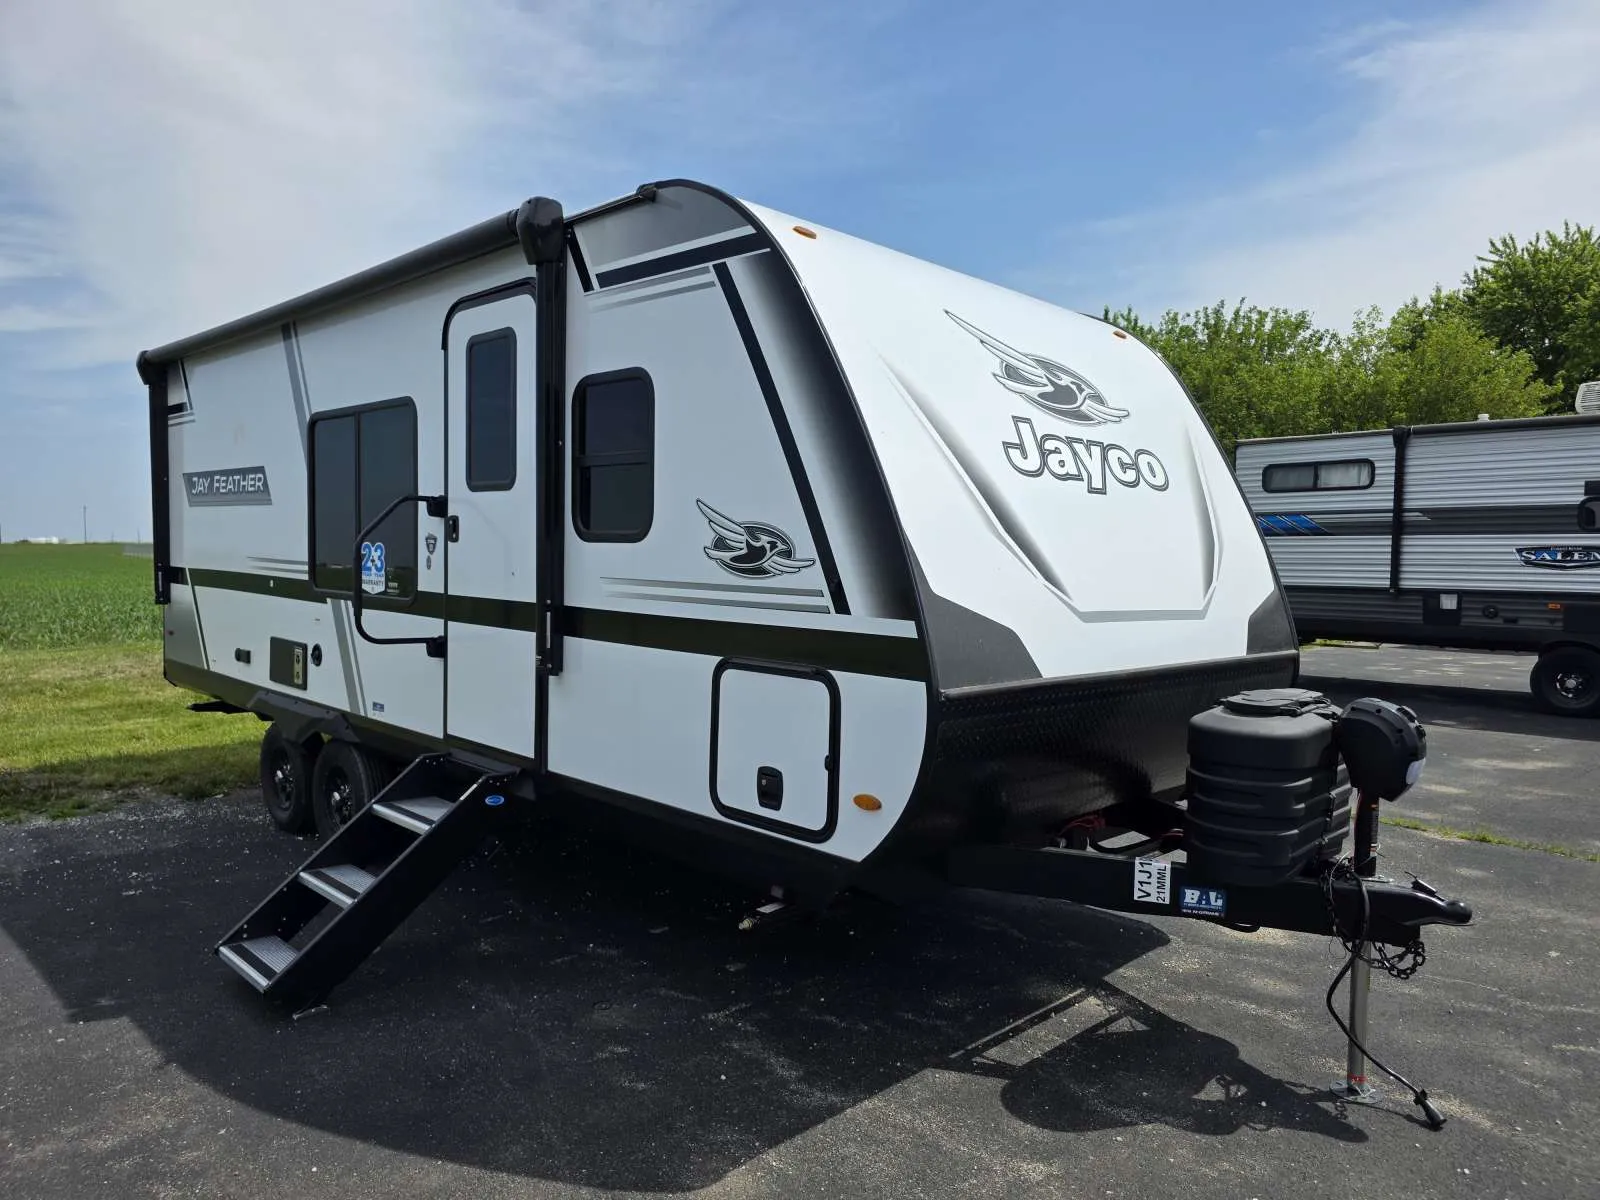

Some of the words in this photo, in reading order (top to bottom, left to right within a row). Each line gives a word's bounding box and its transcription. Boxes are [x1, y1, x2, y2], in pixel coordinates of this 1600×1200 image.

[1002, 416, 1170, 495] Jayco
[192, 477, 210, 495] JAY
[213, 474, 265, 493] FEATHER
[1156, 865, 1168, 902] 21MML
